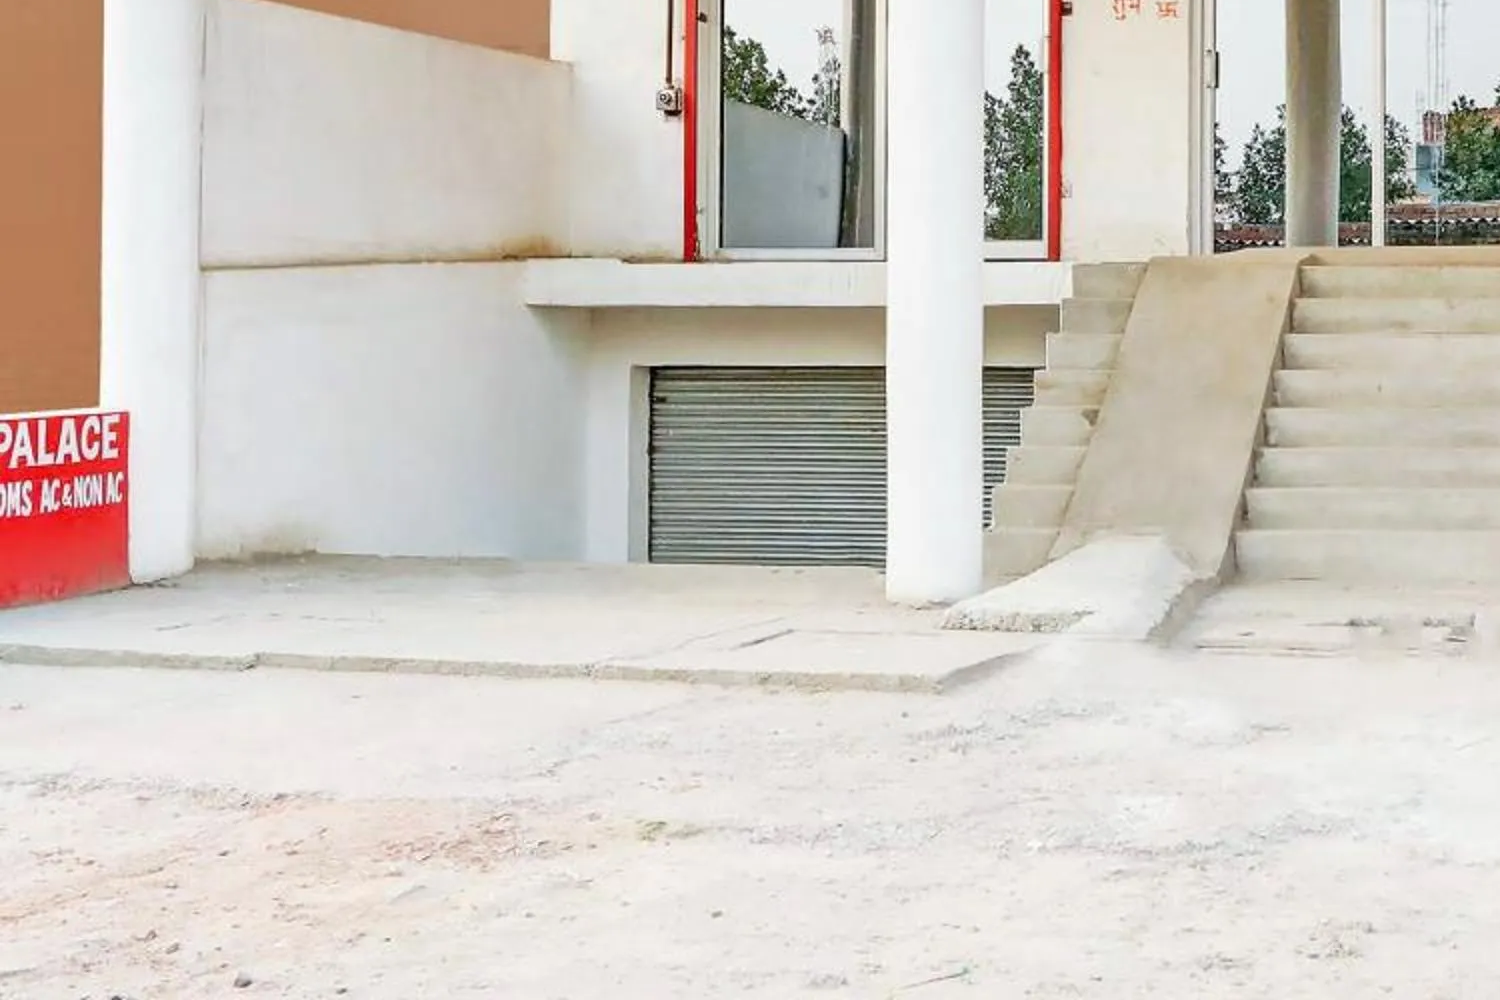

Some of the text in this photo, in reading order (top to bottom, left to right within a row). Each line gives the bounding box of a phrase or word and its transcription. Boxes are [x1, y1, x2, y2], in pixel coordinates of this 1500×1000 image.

[40, 478, 60, 514] AC
[62, 483, 72, 507] &
[74, 473, 103, 509] NON
[106, 471, 124, 504] AC
